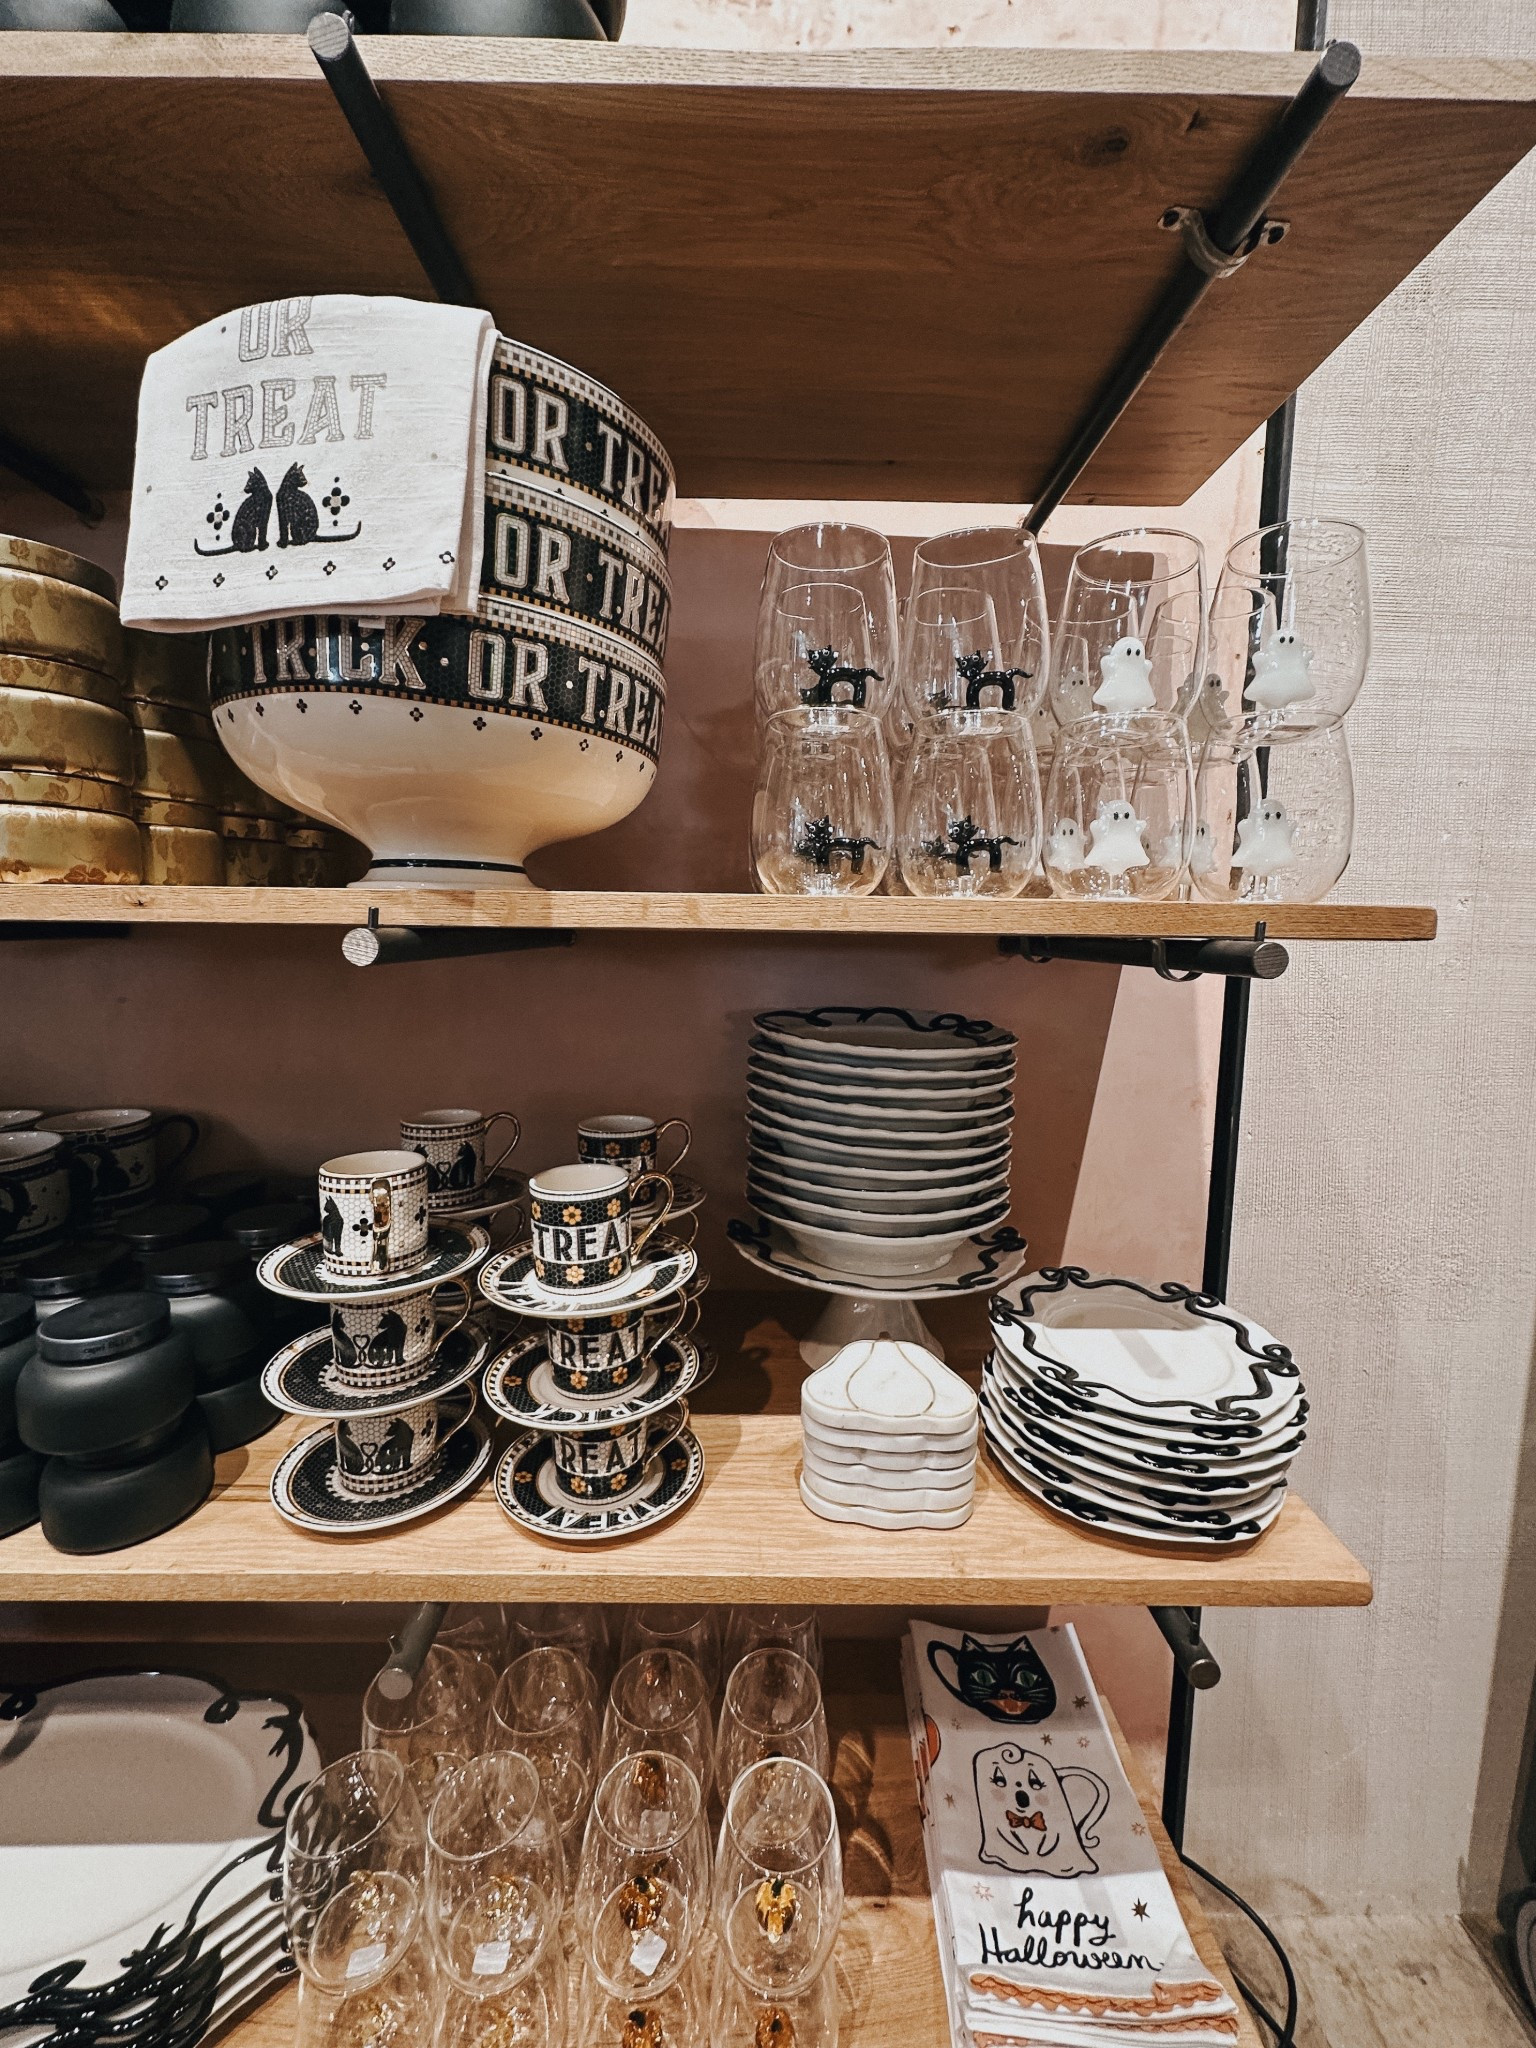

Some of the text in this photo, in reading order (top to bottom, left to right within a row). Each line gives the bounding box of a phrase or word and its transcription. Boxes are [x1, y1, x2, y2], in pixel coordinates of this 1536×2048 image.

[238, 296, 315, 362] OR
[186, 372, 388, 460] TREAT
[491, 374, 570, 473] OR
[494, 512, 572, 604] OR
[244, 614, 427, 690] TRICK
[467, 629, 549, 713] OR
[553, 1424, 642, 1475] REAT
[978, 1922, 1165, 1972] Halloween
[1013, 1886, 1117, 1946] happy
